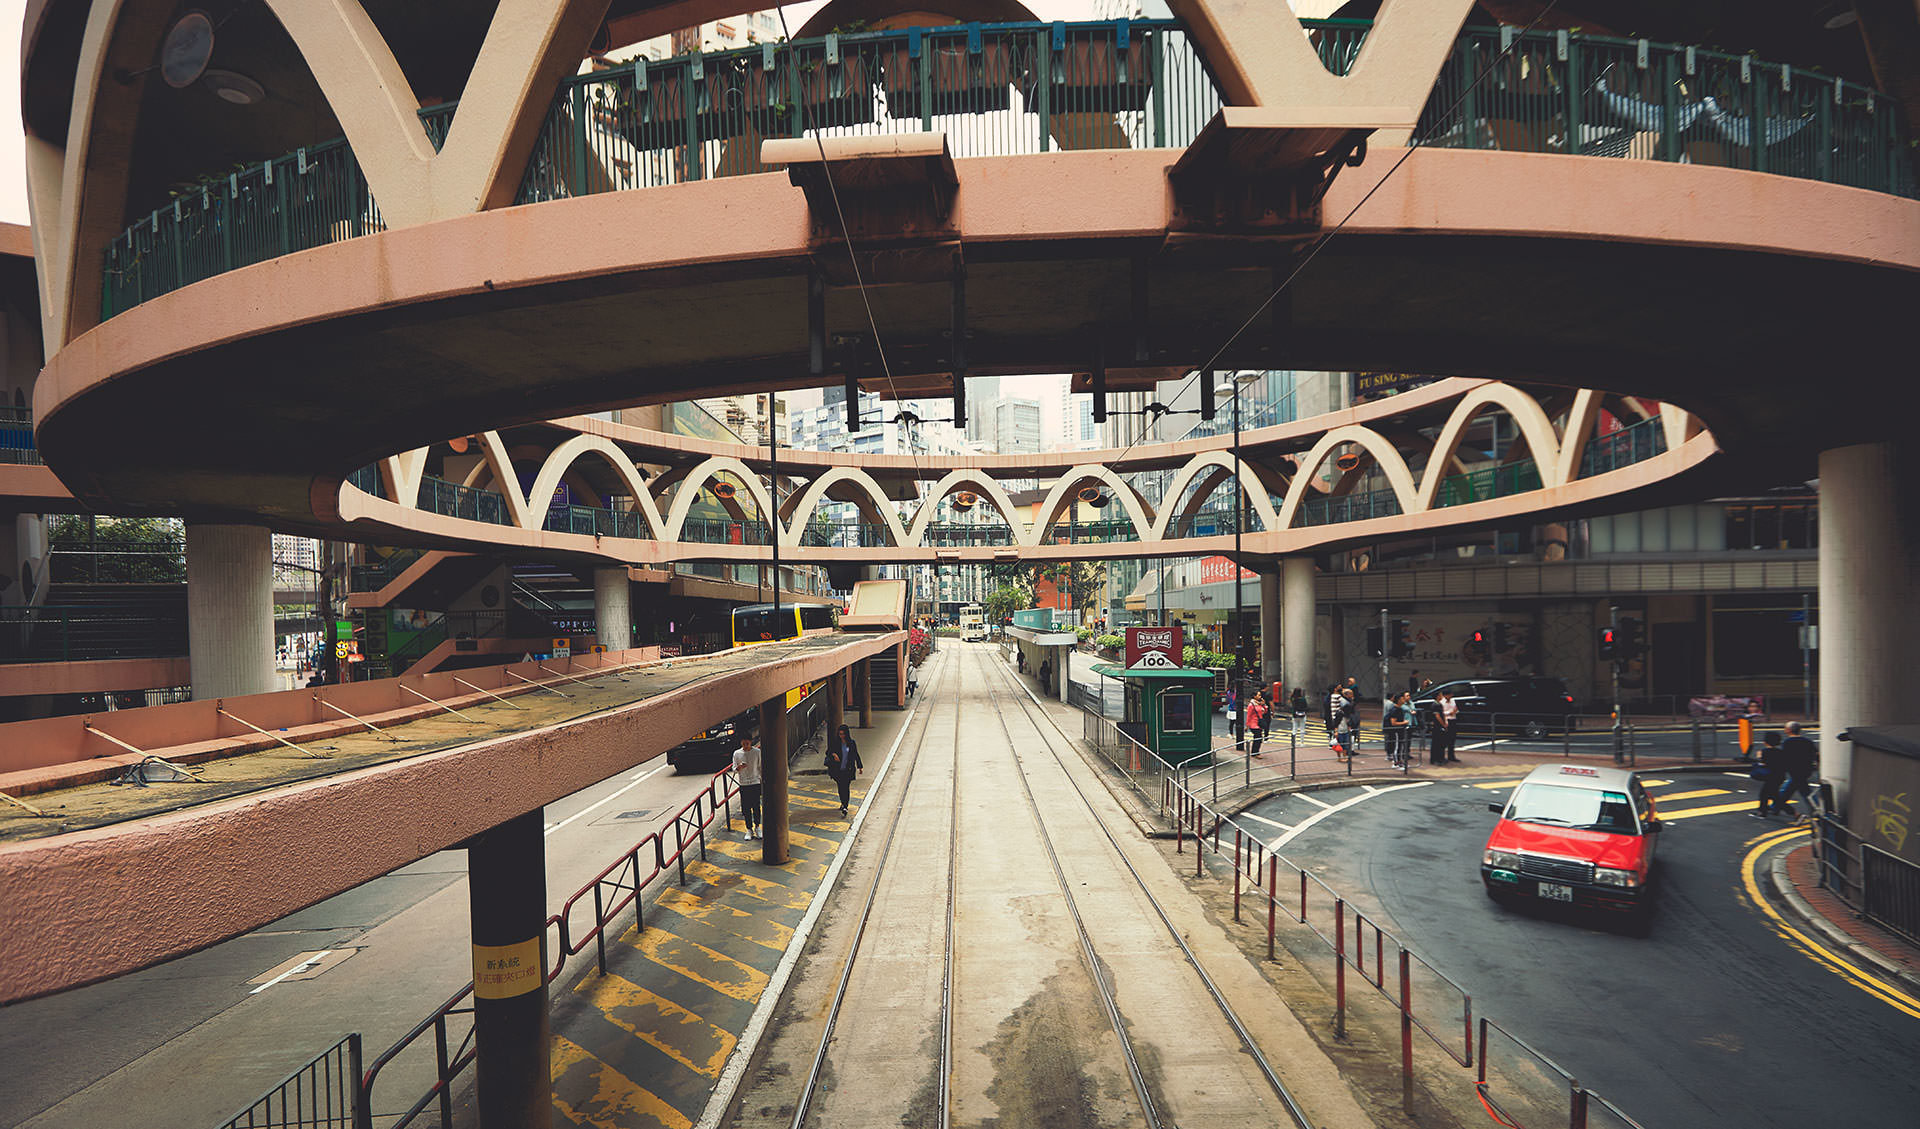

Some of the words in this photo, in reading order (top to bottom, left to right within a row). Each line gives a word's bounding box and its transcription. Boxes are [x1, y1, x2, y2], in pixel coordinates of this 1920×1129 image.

[1359, 377, 1372, 390] FU
[1374, 373, 1398, 386] SING
[1143, 657, 1165, 666] 100
[1562, 766, 1595, 775] TAXI
